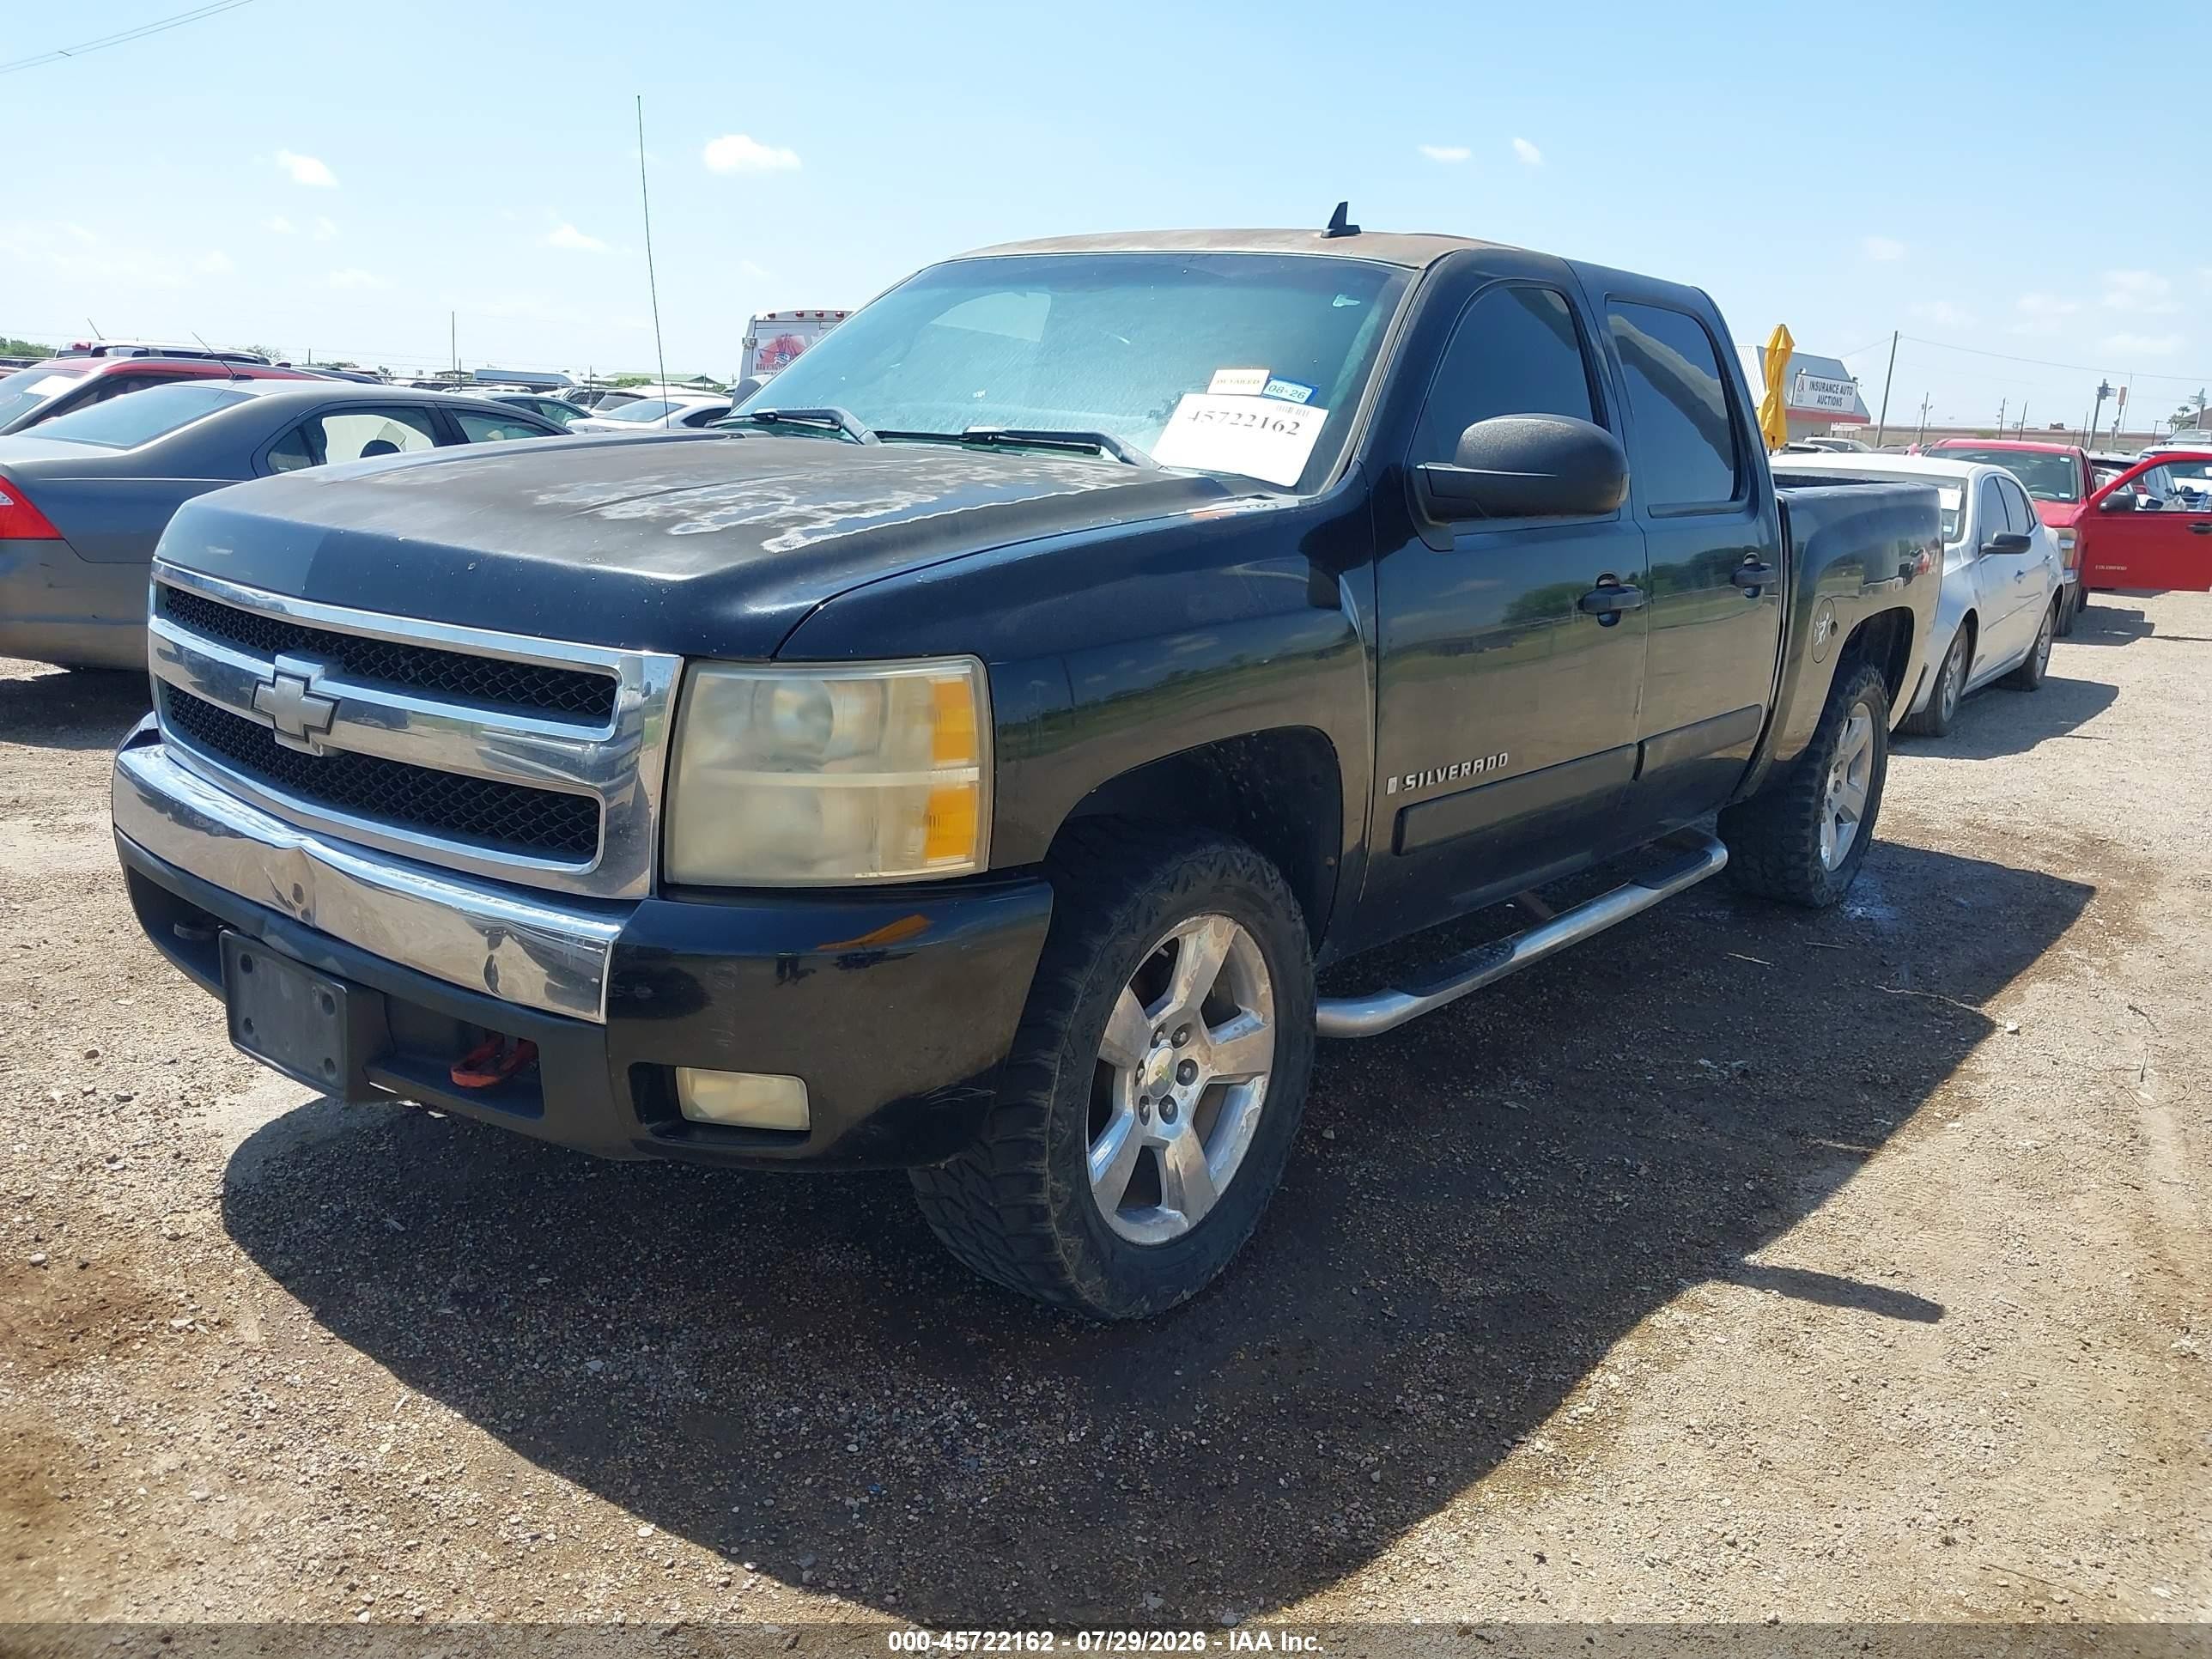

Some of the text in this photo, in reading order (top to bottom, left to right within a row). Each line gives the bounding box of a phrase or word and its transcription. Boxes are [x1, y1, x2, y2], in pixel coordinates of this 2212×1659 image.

[1267, 383, 1307, 400] 08-26
[1808, 380, 1839, 395] INSURANCE
[1839, 383, 1853, 397] AUTO
[1816, 395, 1843, 408] AUCTIONS
[1187, 410, 1301, 436] 45722162
[1403, 752, 1509, 791] SILVERADO
